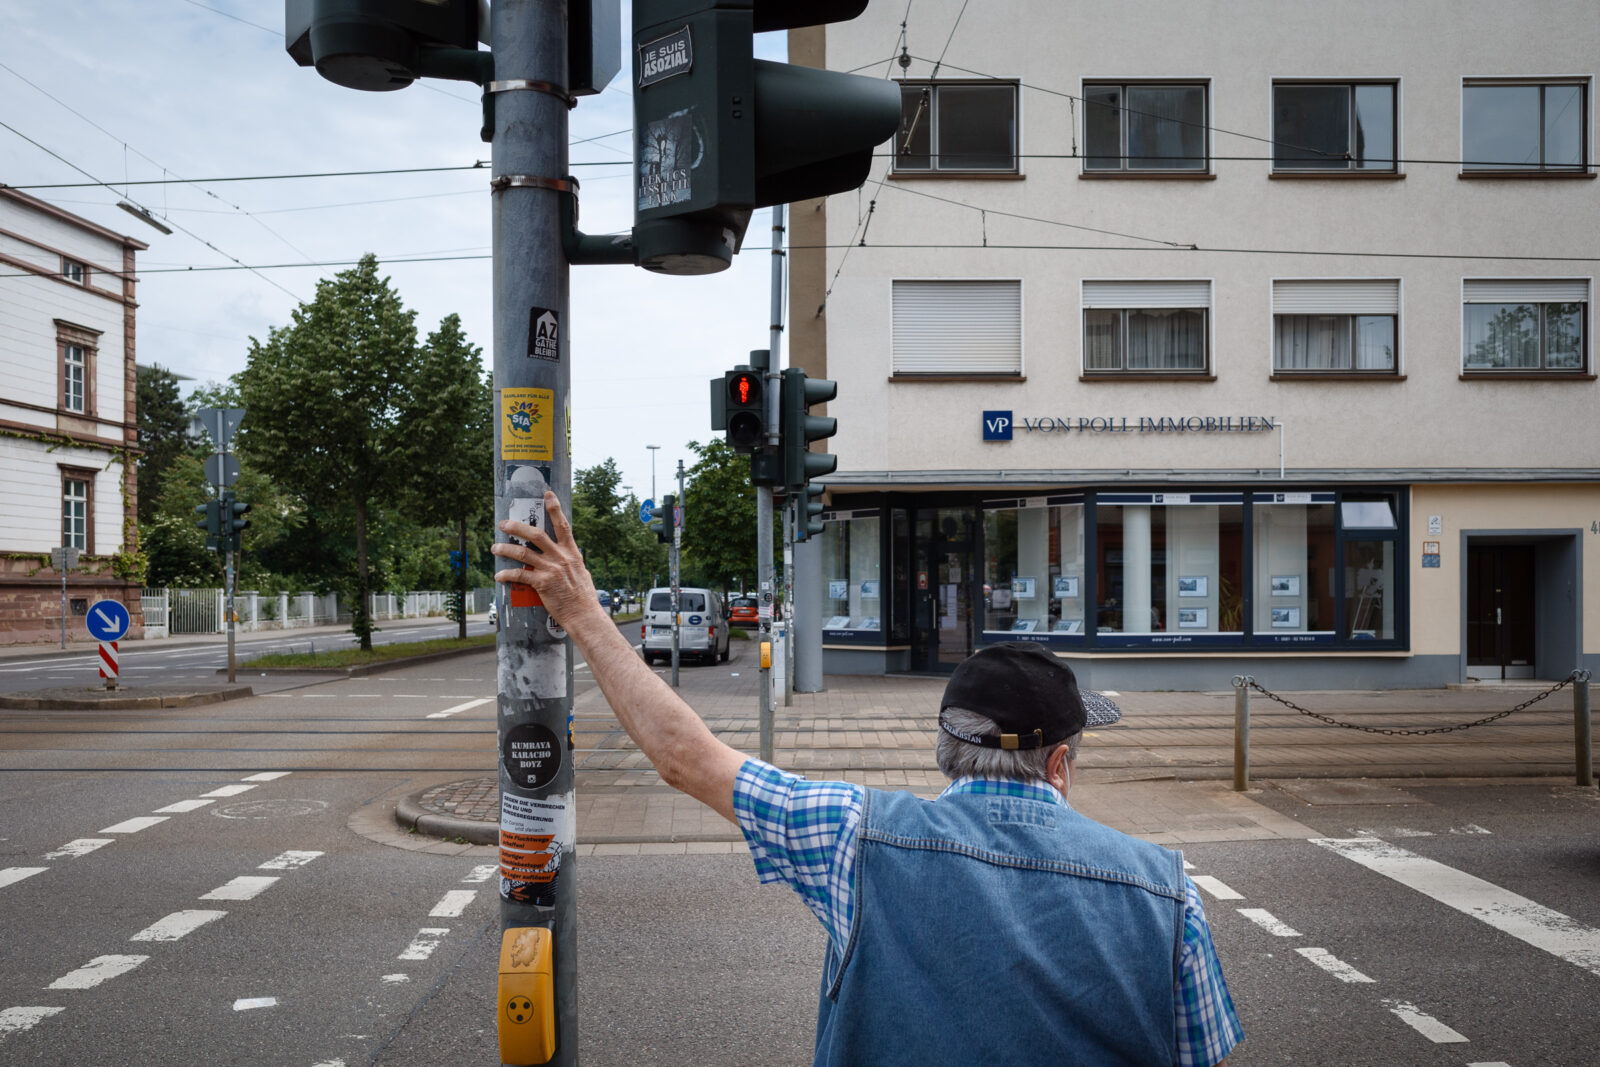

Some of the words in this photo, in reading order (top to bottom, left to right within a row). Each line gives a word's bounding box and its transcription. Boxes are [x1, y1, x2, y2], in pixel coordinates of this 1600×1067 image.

[644, 50, 657, 63] JE
[659, 40, 686, 57] SUIS
[644, 49, 689, 78] ASOZIAL
[537, 320, 557, 340] AZ
[535, 337, 557, 350] GATHE
[986, 417, 1009, 433] VP
[1024, 416, 1072, 433] VON
[1078, 416, 1134, 433] POLL
[1139, 416, 1275, 432] IMMOBILIEN
[1590, 520, 1600, 535] 4
[511, 741, 551, 750] KUMBAYA
[511, 750, 552, 759] KARACHO
[520, 760, 542, 768] BOYZ
